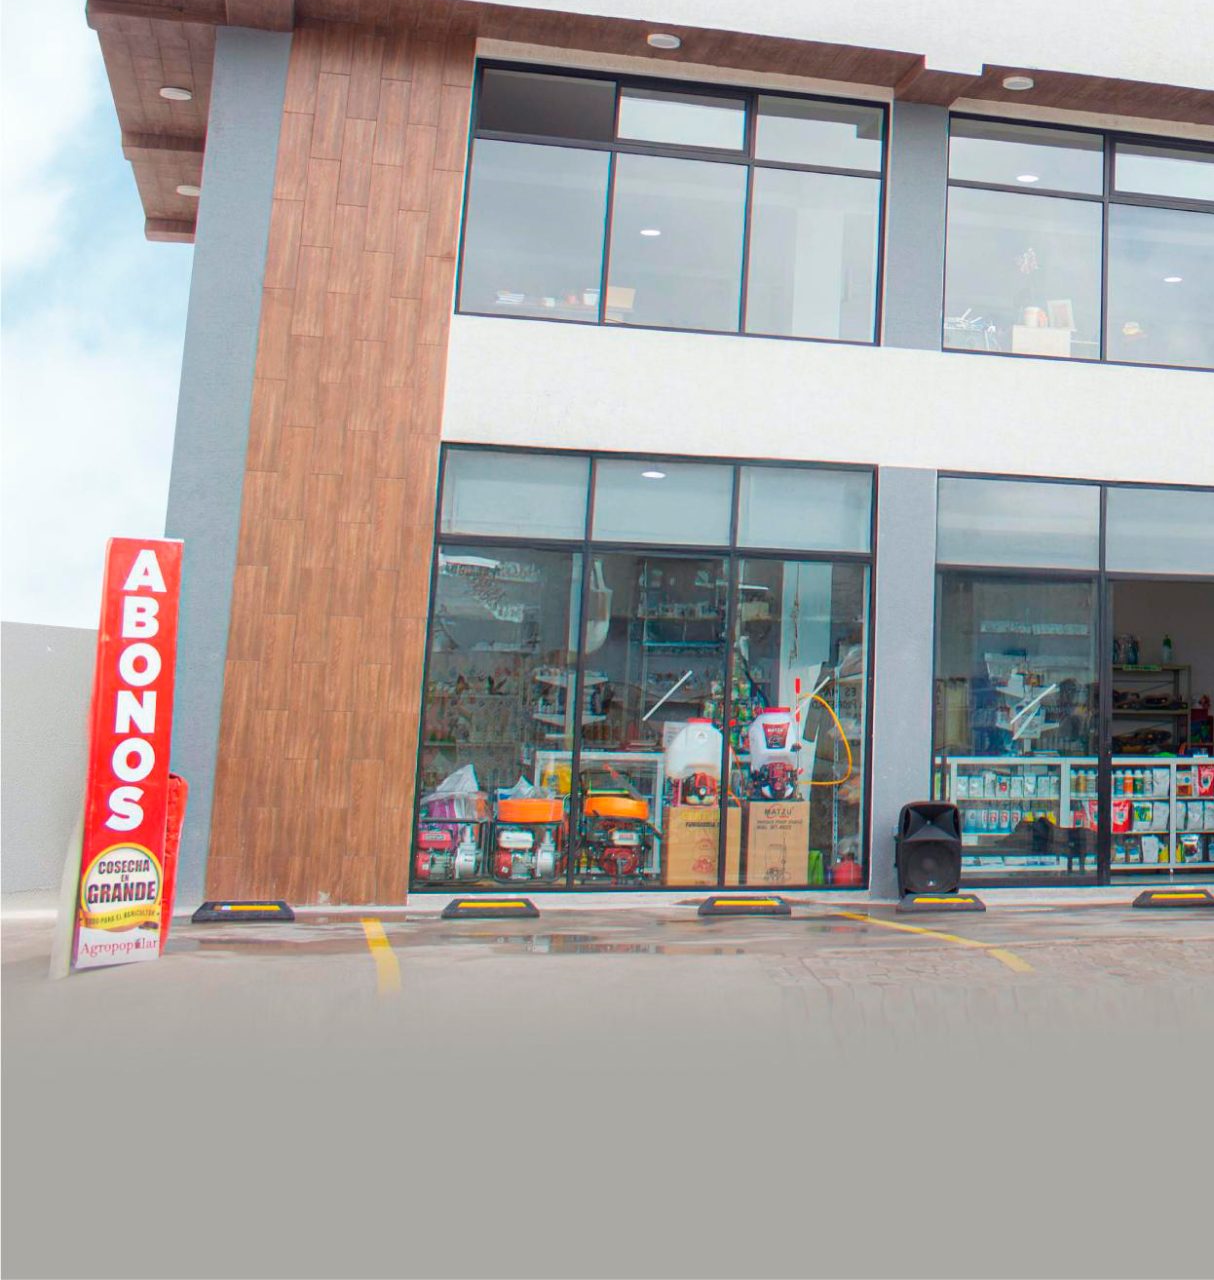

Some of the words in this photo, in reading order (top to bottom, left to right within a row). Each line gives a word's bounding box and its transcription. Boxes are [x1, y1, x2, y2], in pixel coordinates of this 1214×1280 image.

[104, 548, 168, 832] ABONOS
[97, 859, 150, 875] COSECHA
[87, 880, 156, 905] GRANDE
